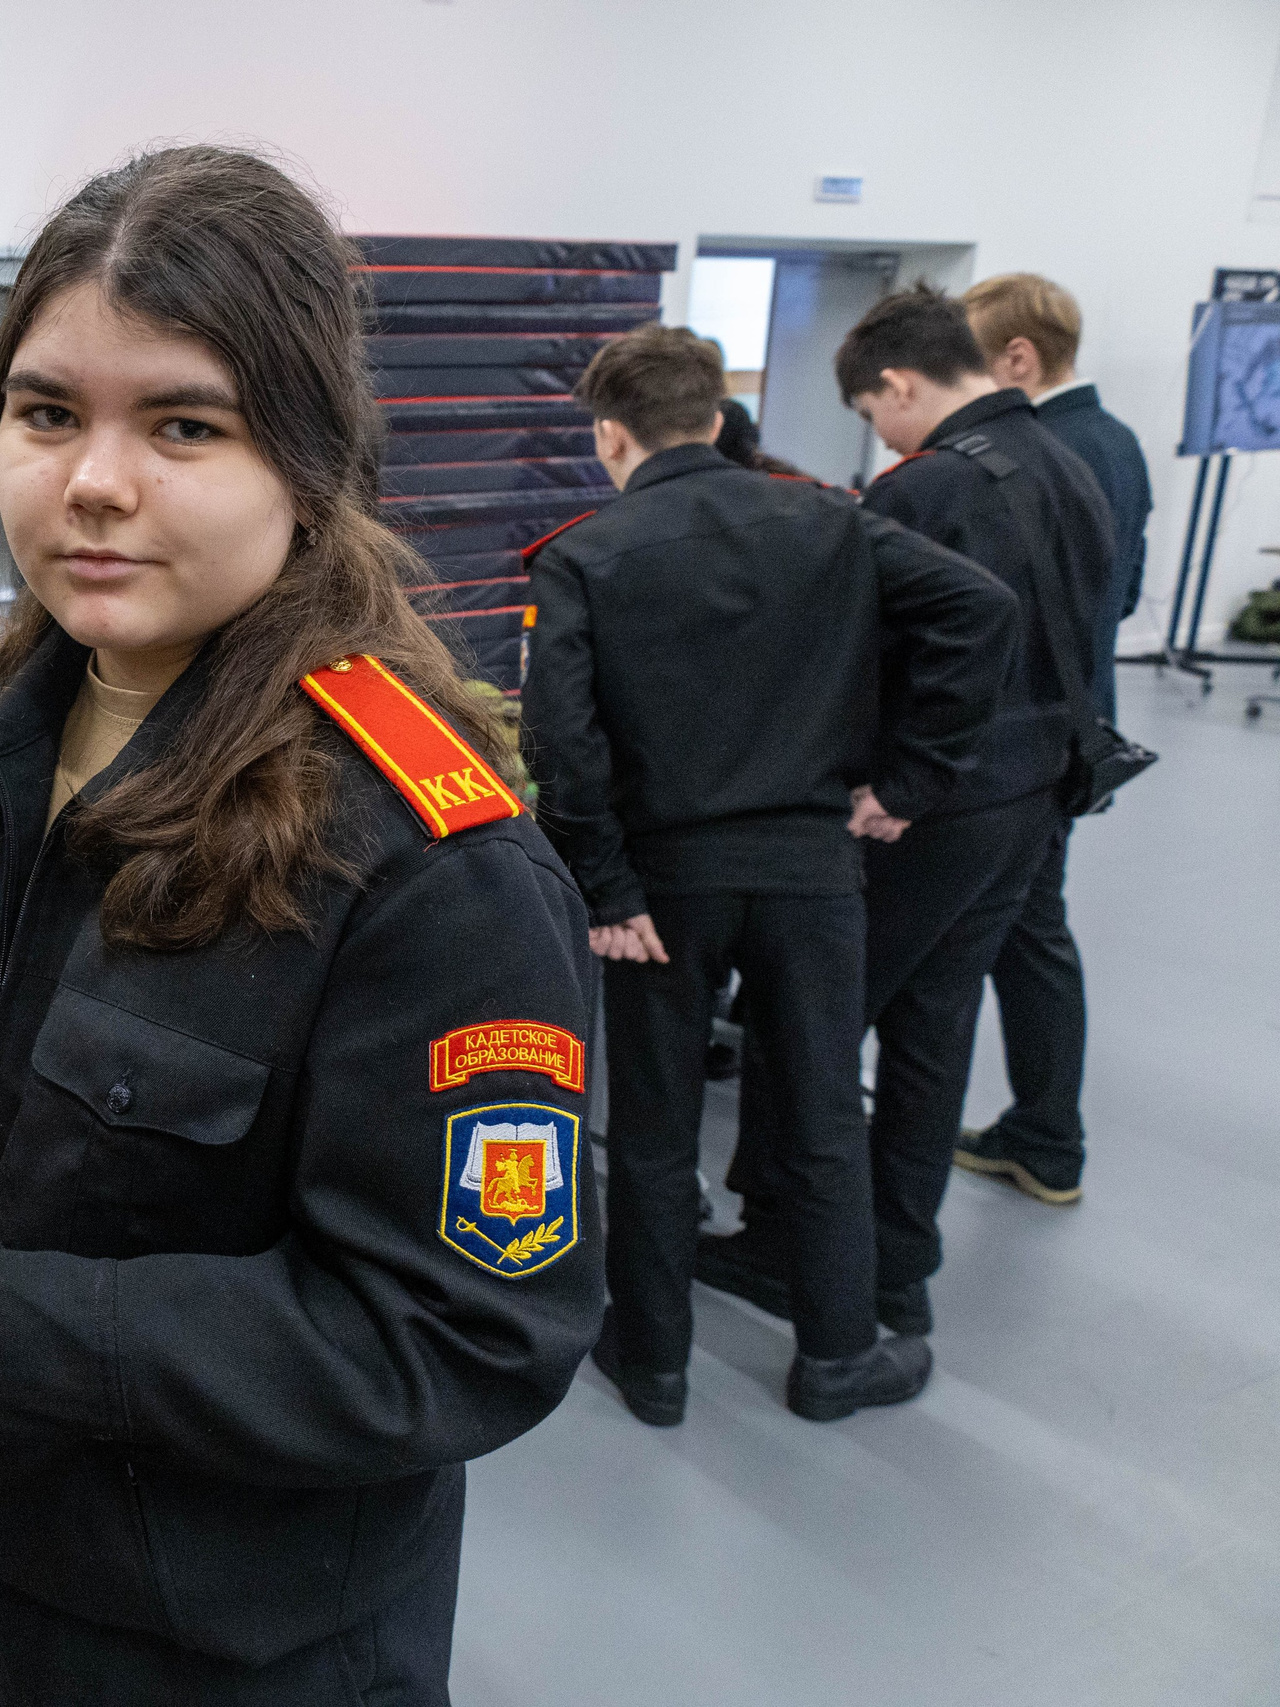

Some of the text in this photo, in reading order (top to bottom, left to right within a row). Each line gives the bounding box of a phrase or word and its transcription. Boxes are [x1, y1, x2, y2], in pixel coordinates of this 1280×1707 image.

[419, 767, 496, 810] КК
[465, 1029, 558, 1051] КАДЕТСКОЕ
[455, 1047, 566, 1070] ОБРАЗОВАНИЕ
